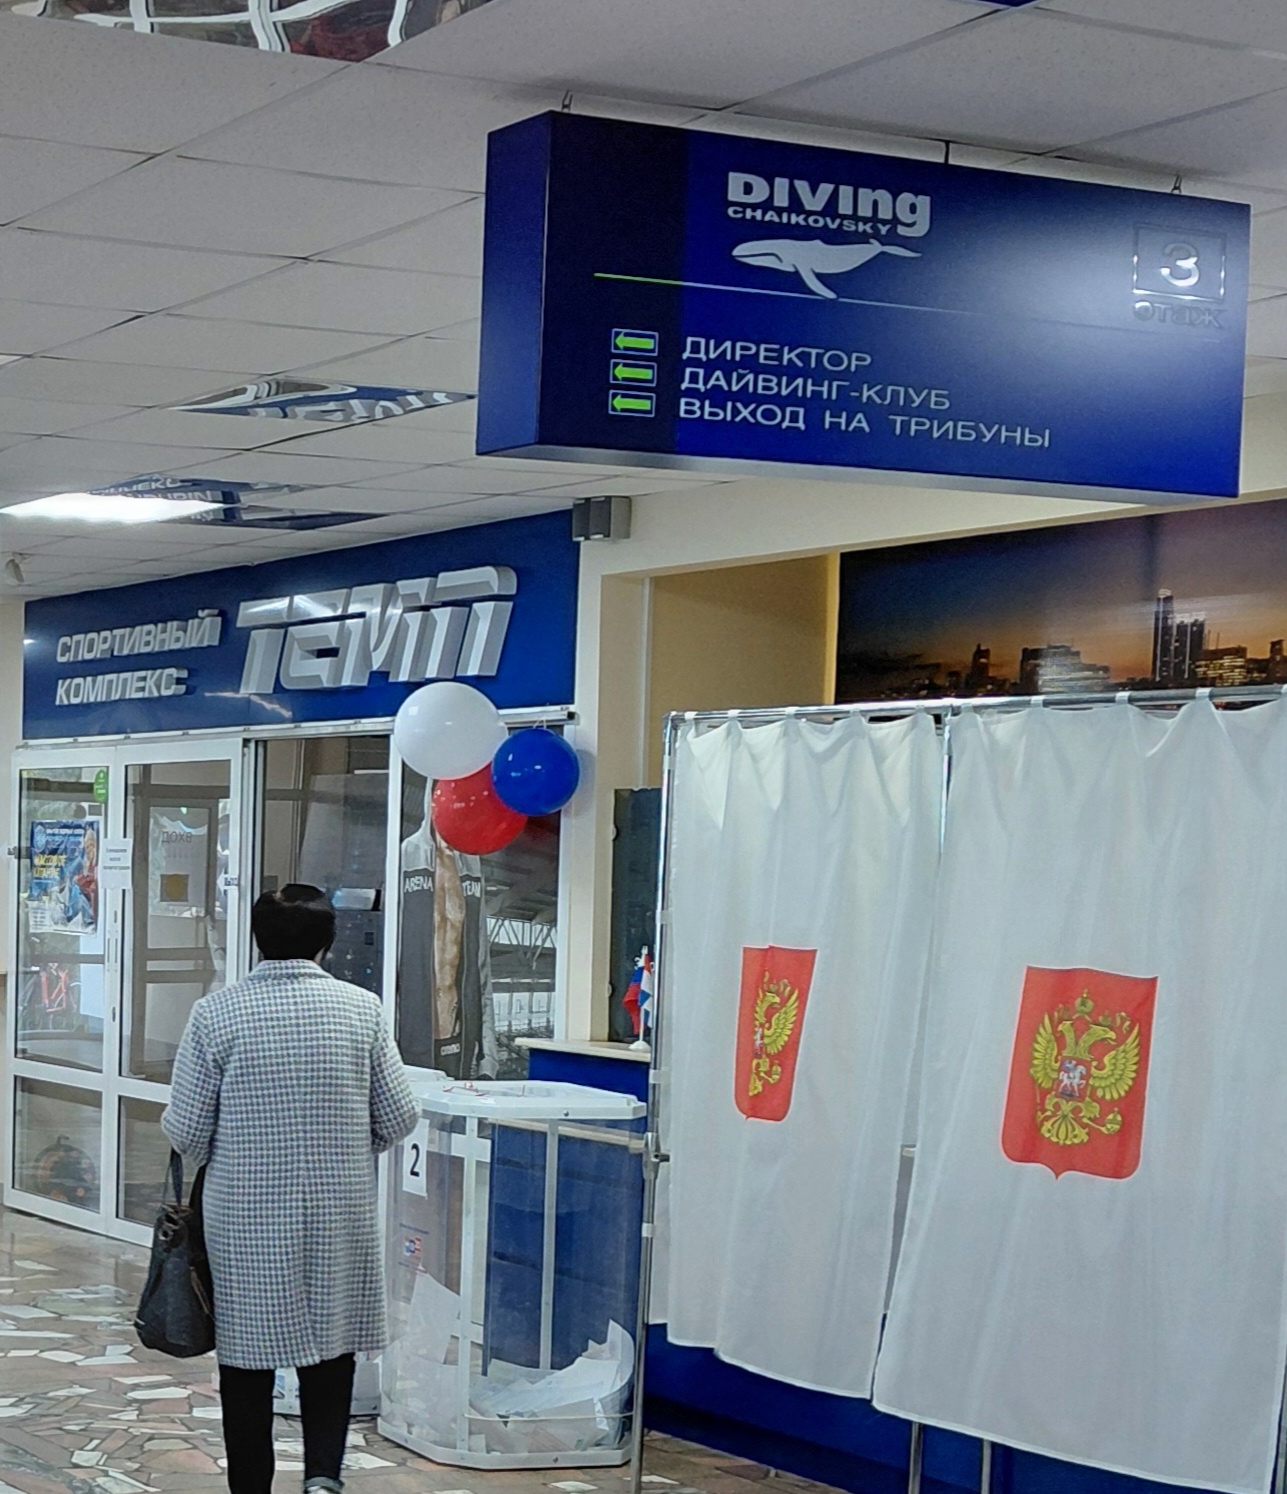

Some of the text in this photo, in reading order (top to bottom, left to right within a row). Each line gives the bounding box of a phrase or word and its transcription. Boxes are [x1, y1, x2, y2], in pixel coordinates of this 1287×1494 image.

[727, 206, 892, 235] CHAIKOVSKY
[1161, 242, 1200, 287] 3
[682, 336, 872, 372] ДИРЕКТОР
[680, 367, 951, 410] ДАЙВИНГ-КЛУБ
[679, 398, 1051, 448] ВЫХОД НА ТРИБУНЫ
[56, 609, 223, 664] СПОРТИВНЫЙ
[55, 667, 188, 706] КОМПЛЕКС
[409, 1143, 421, 1177] 2
